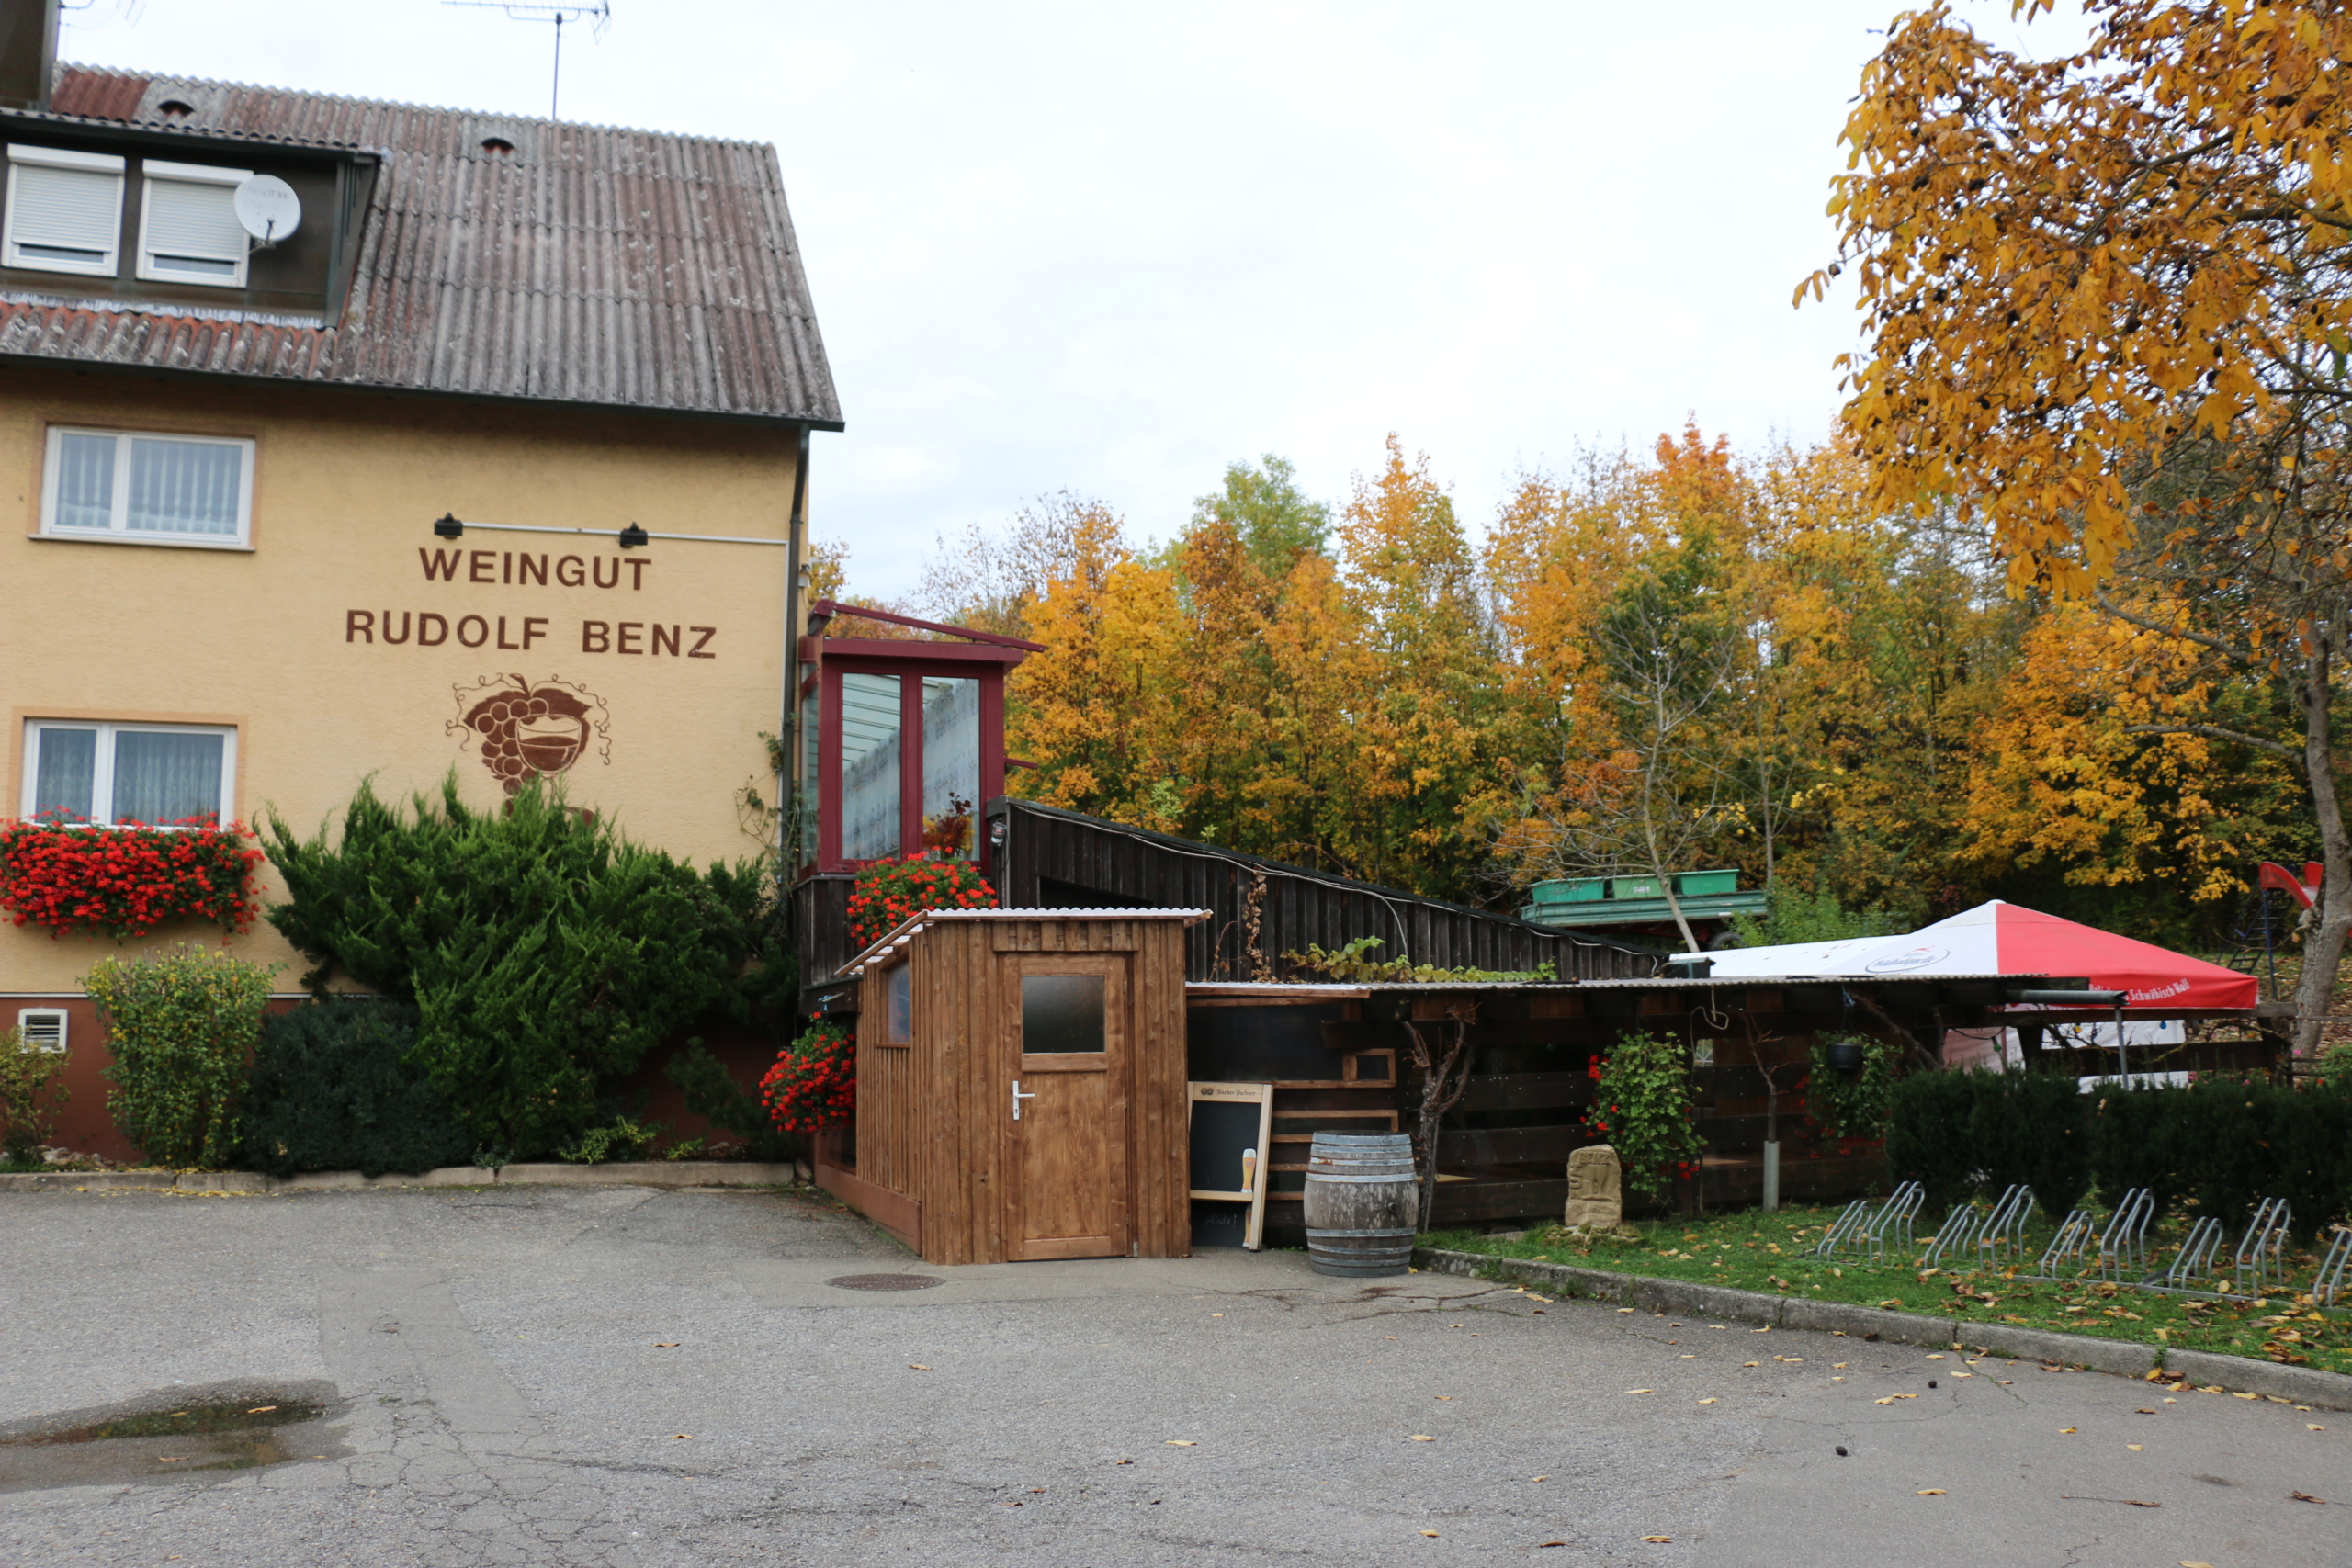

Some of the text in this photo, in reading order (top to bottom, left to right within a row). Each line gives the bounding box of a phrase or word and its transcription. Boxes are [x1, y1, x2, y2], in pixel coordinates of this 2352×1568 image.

[419, 547, 651, 591] WEINGUT
[345, 609, 718, 660] RUDOLF BENZ
[2129, 985, 2176, 1001] Schwäbisch
[2173, 977, 2191, 994] Hall
